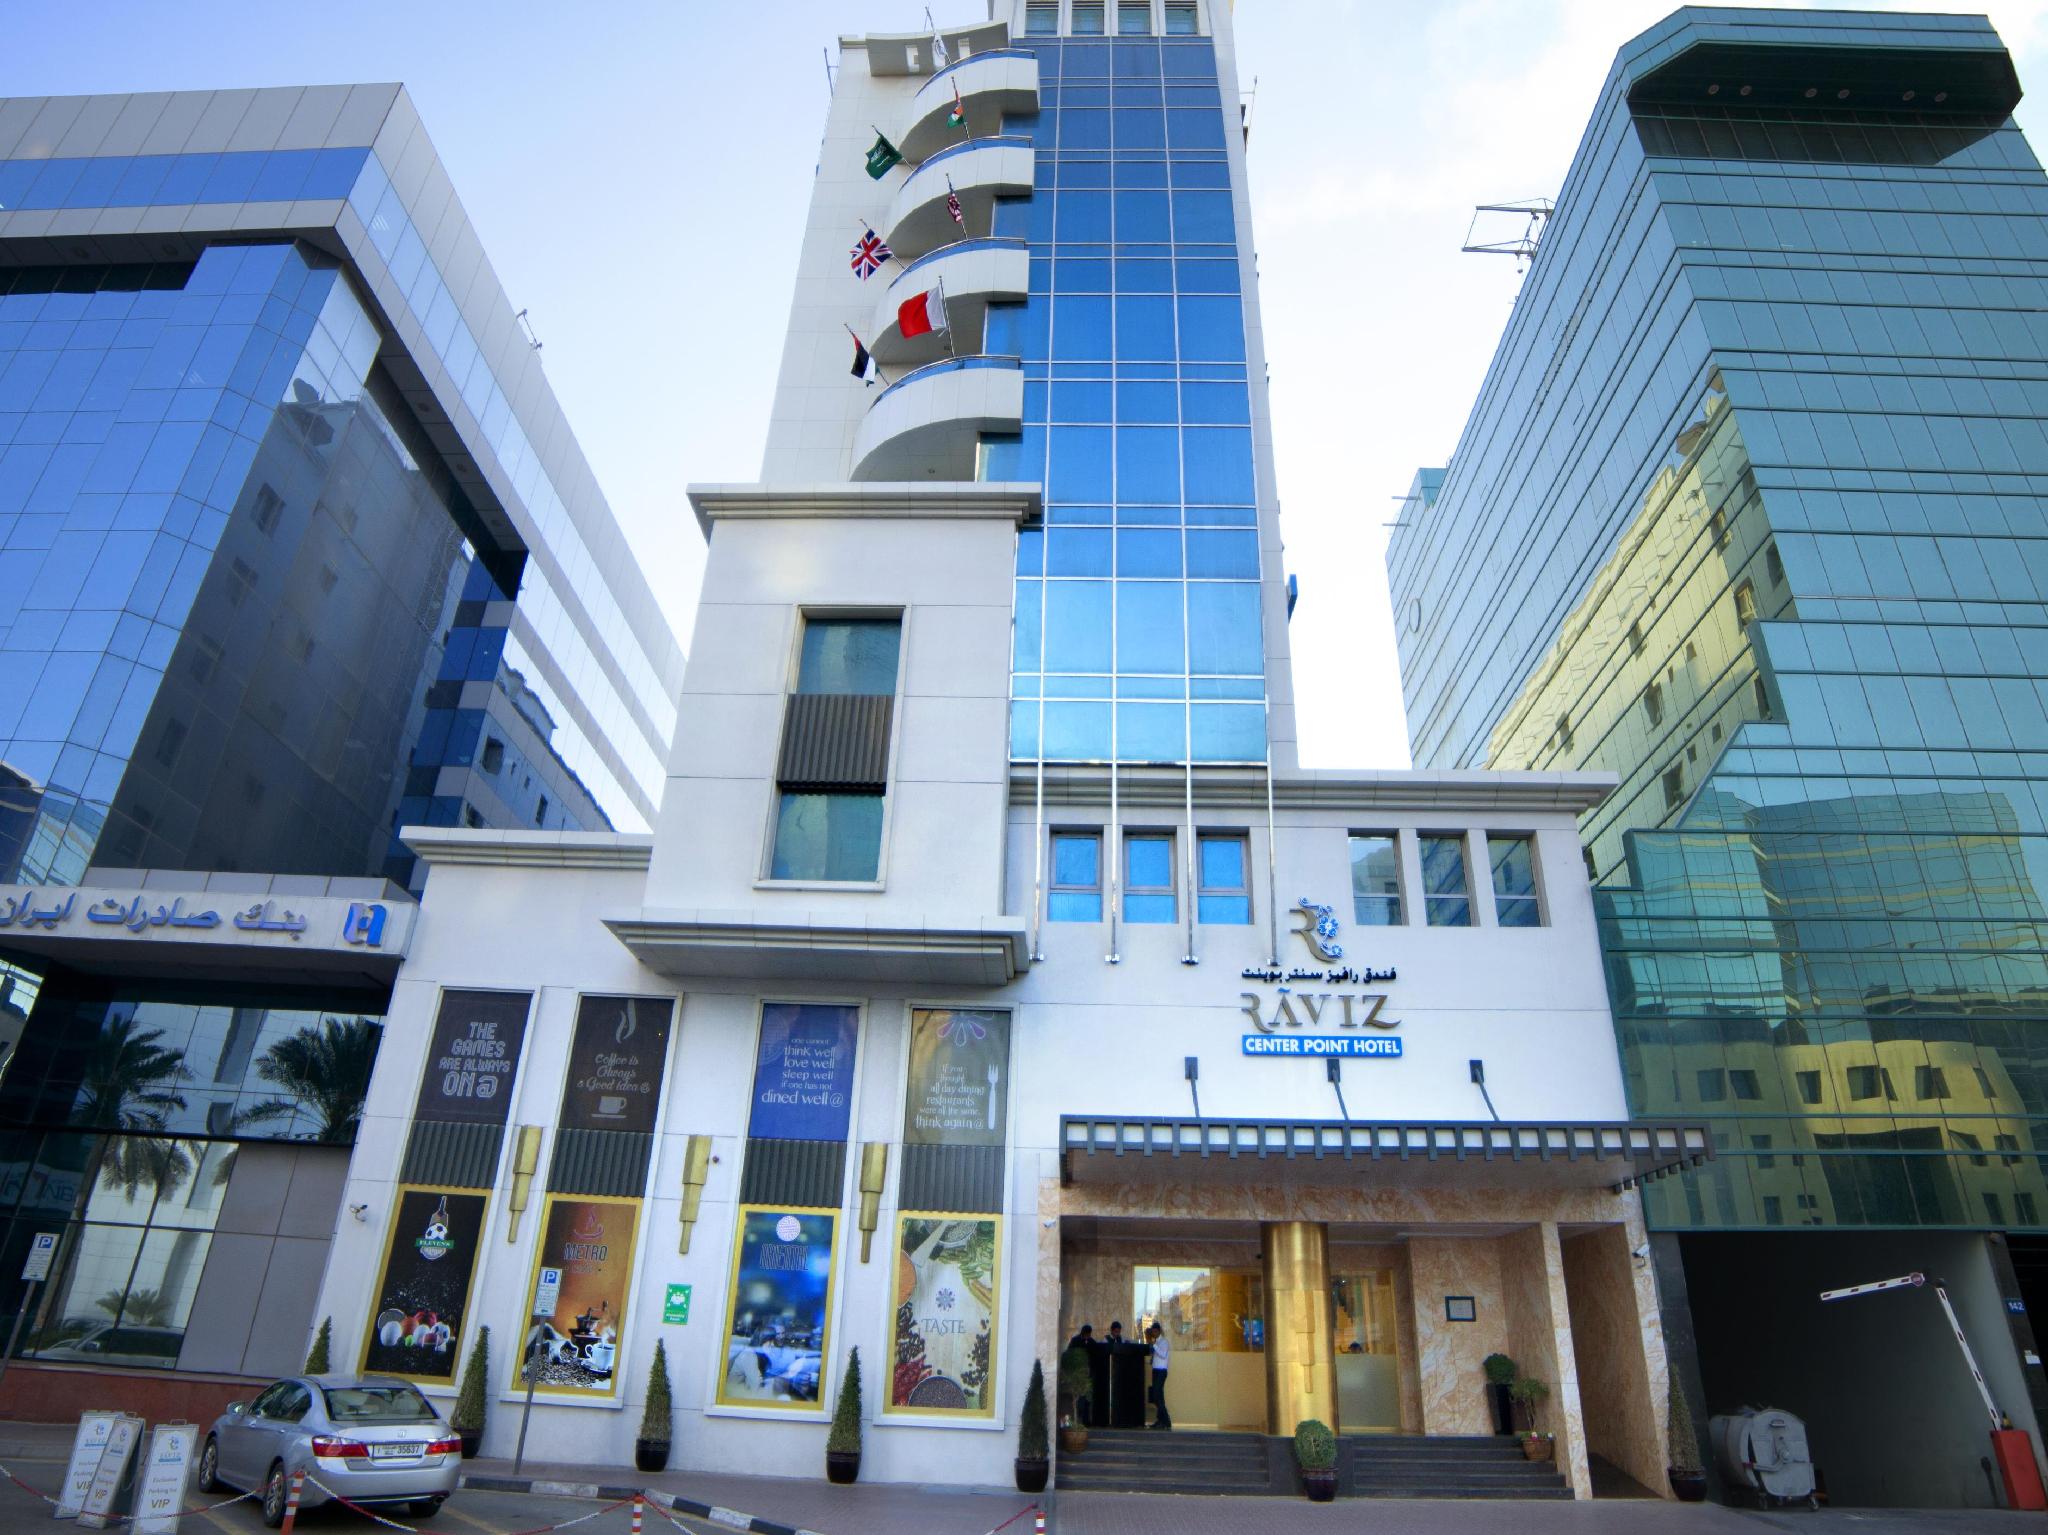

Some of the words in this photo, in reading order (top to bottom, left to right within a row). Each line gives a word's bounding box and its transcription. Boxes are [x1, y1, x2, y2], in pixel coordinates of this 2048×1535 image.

[87, 895, 223, 933] صادرات
[1285, 967, 1323, 982] سنتر
[1326, 966, 1359, 984] رافيز
[1363, 967, 1397, 984] فندق
[469, 1021, 498, 1040] THE
[451, 1038, 506, 1058] GAMES
[784, 1045, 811, 1057] think
[814, 1046, 836, 1058] well
[1245, 1038, 1299, 1053] CENTER
[1304, 1038, 1349, 1053] POINT
[1354, 1039, 1400, 1054] HOTEL
[439, 1056, 462, 1070] ARE
[463, 1058, 511, 1073] ALWAYS
[783, 1056, 809, 1068] love
[812, 1058, 835, 1069] well
[782, 1069, 810, 1081] sleep
[813, 1070, 834, 1080] well
[442, 1071, 476, 1097] ON
[761, 1089, 799, 1104] dined
[563, 1242, 609, 1262] METRO
[920, 1318, 967, 1337] TASTE
[151, 1499, 171, 1509] VIP
